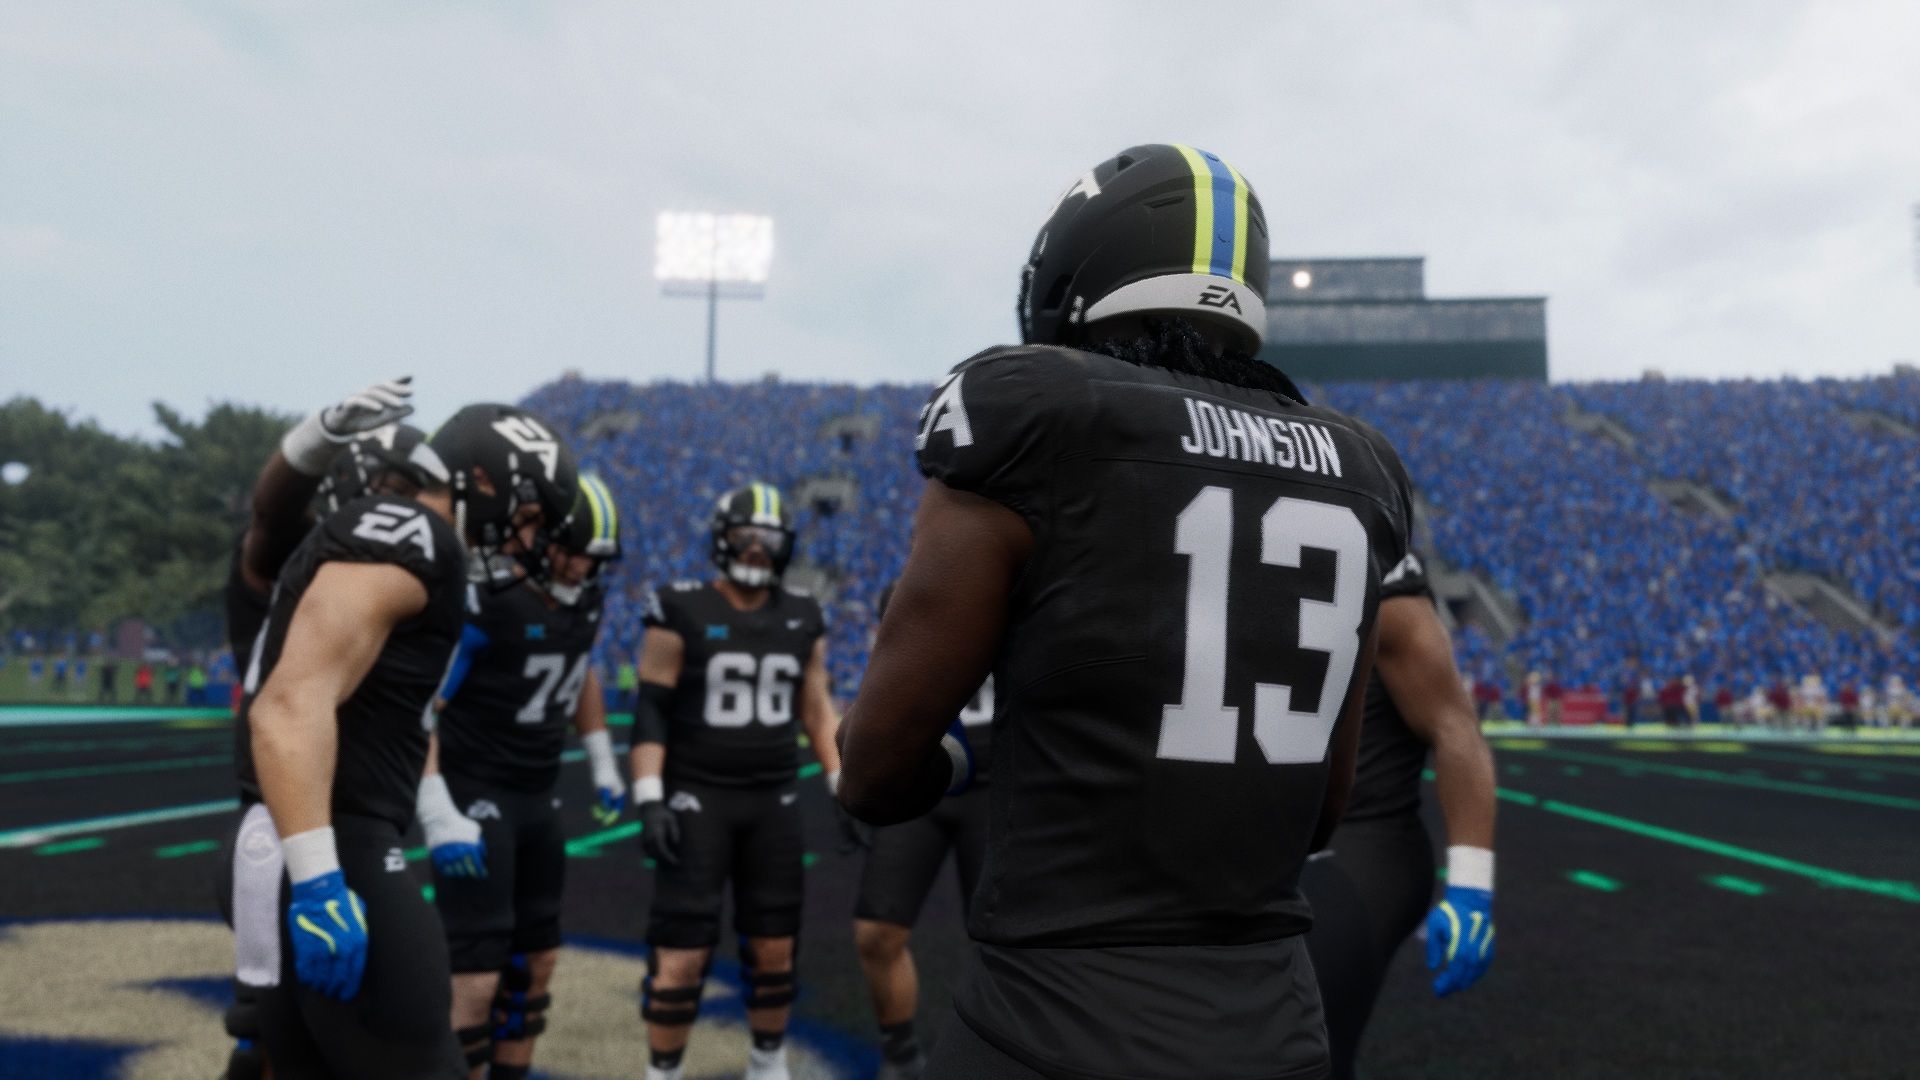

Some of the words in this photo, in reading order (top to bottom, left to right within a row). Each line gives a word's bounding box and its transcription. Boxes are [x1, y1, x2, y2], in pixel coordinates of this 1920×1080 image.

[1197, 284, 1243, 316] EA
[492, 414, 558, 482] EA
[1180, 397, 1343, 478] JOHNSON
[352, 502, 436, 562] EA
[1156, 485, 1369, 764] 13
[514, 653, 590, 725] 74
[704, 651, 800, 728] 66
